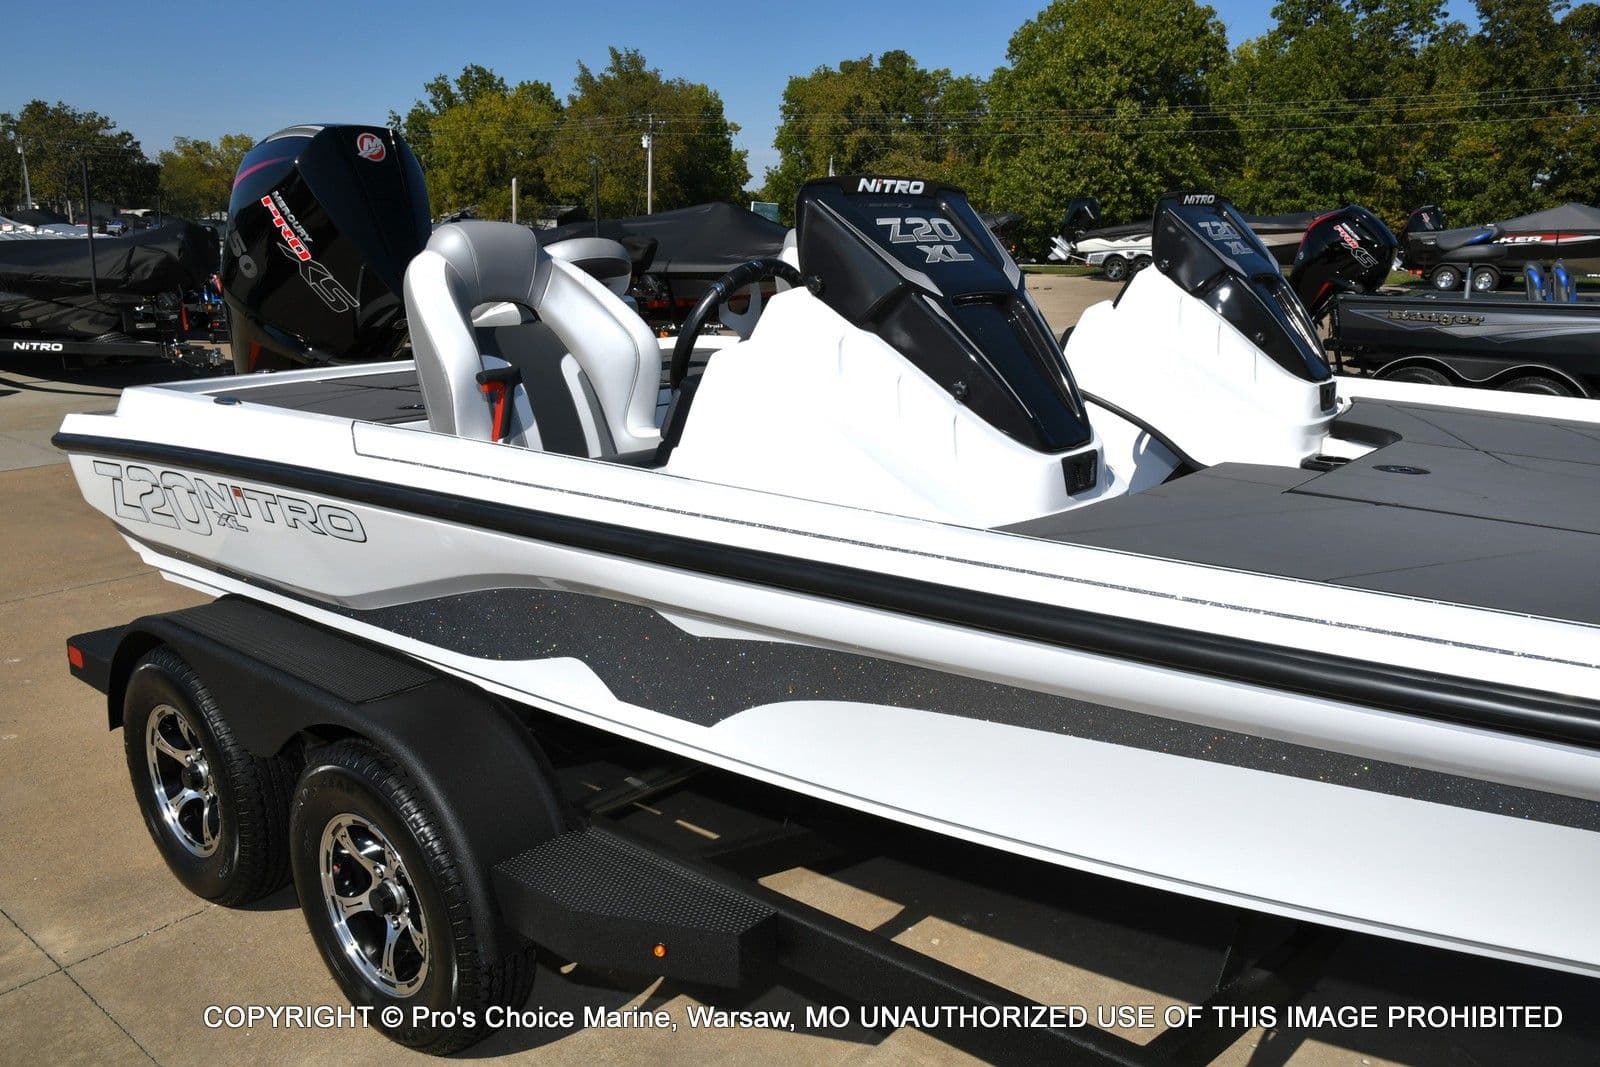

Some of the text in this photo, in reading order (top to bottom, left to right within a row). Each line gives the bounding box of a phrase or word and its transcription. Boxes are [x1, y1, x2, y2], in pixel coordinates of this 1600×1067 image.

[271, 190, 314, 243] MERCURY
[876, 216, 962, 244] Z20
[260, 195, 361, 313] PRO XS
[916, 244, 975, 264] XL
[212, 510, 249, 533] XL
